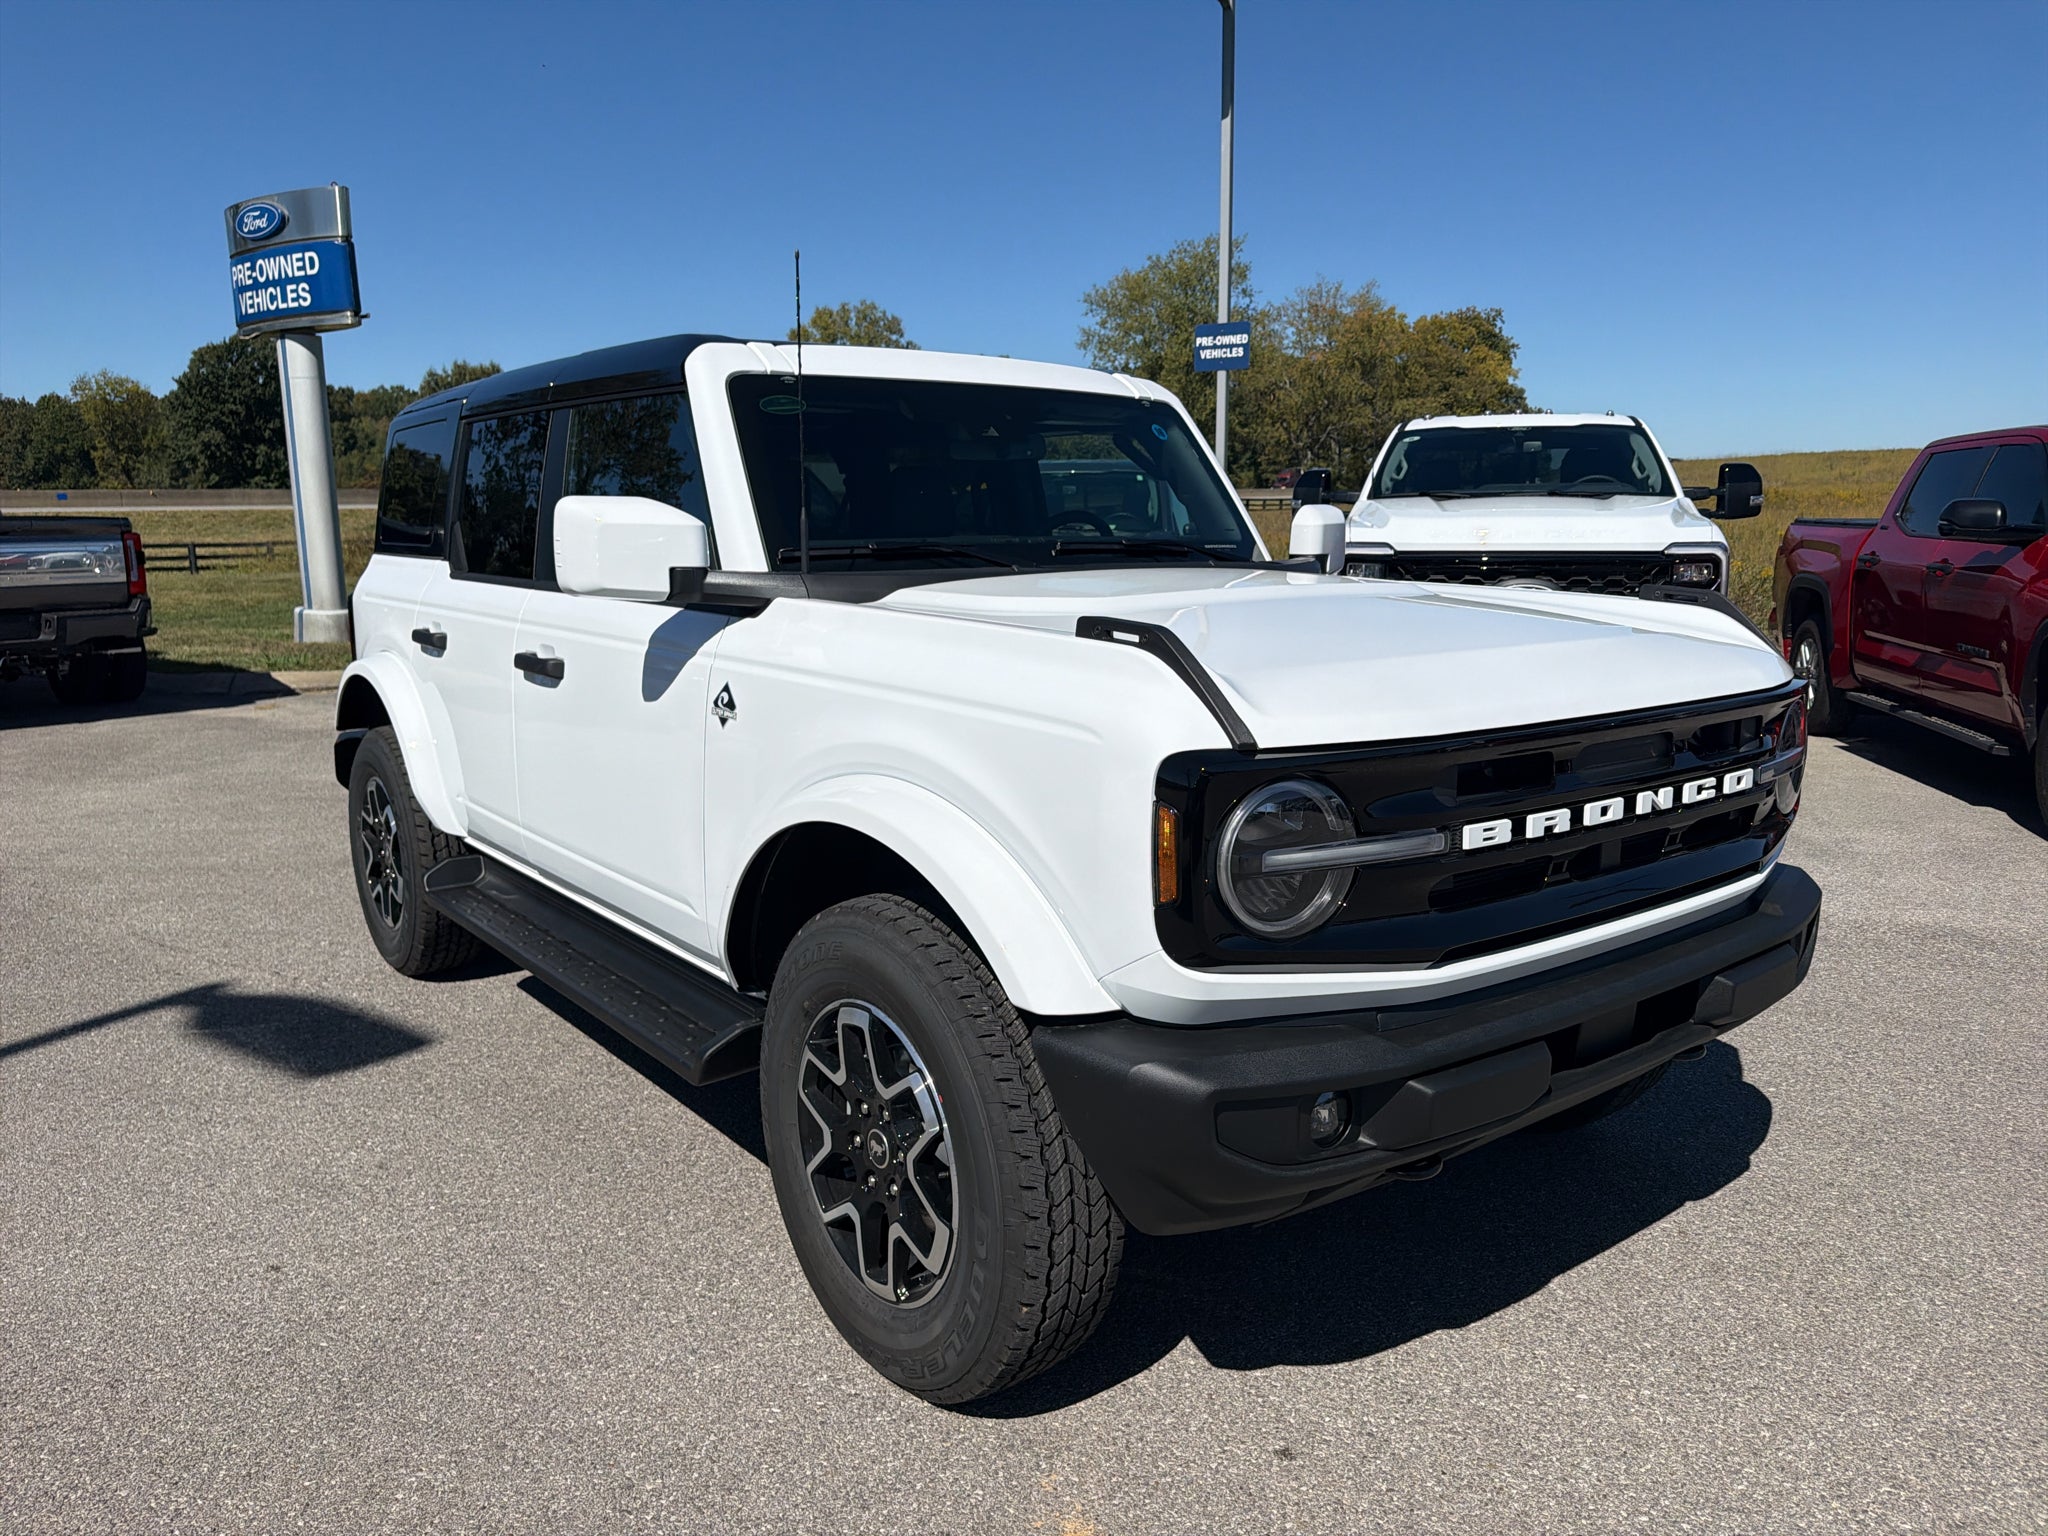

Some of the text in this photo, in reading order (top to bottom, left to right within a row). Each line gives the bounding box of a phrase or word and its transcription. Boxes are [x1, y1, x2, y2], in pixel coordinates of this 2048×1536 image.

[242, 210, 269, 233] Ford
[232, 251, 320, 289] PRE-OWNED
[238, 282, 312, 315] VEHICLES
[1195, 333, 1249, 347] PRE-OWNED
[1199, 347, 1244, 359] VEHICLES
[1462, 768, 1754, 850] BRONCO
